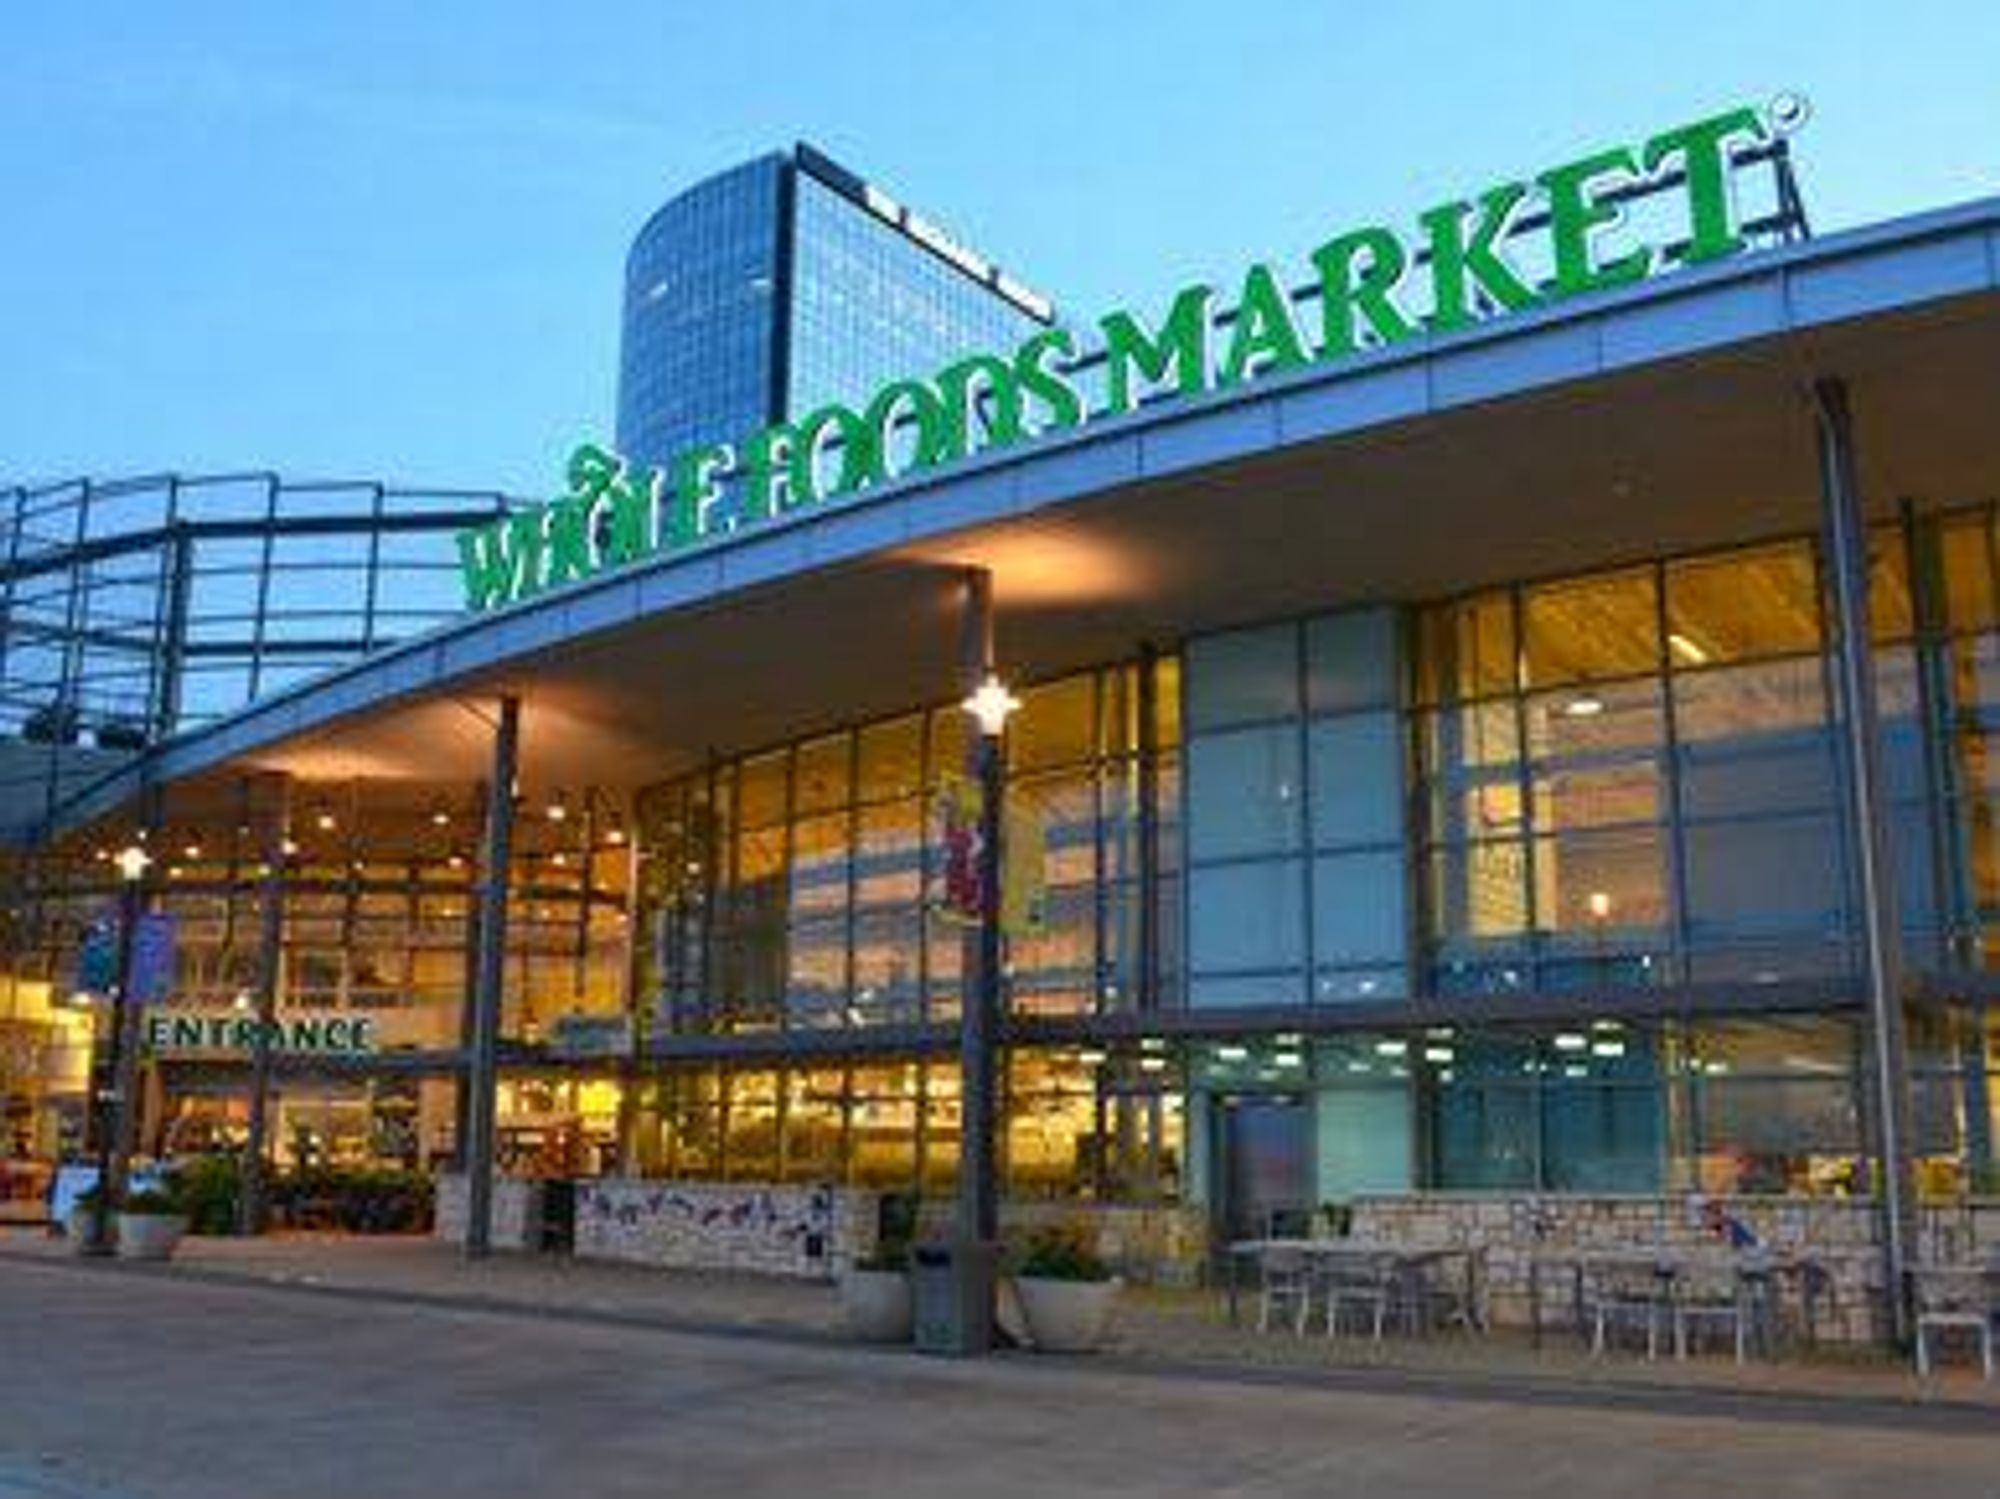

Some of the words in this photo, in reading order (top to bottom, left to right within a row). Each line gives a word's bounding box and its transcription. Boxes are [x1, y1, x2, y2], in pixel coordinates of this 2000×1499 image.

[456, 443, 735, 611] WHOLE
[744, 326, 1085, 519] FOODS
[1098, 107, 1765, 410] MARKET
